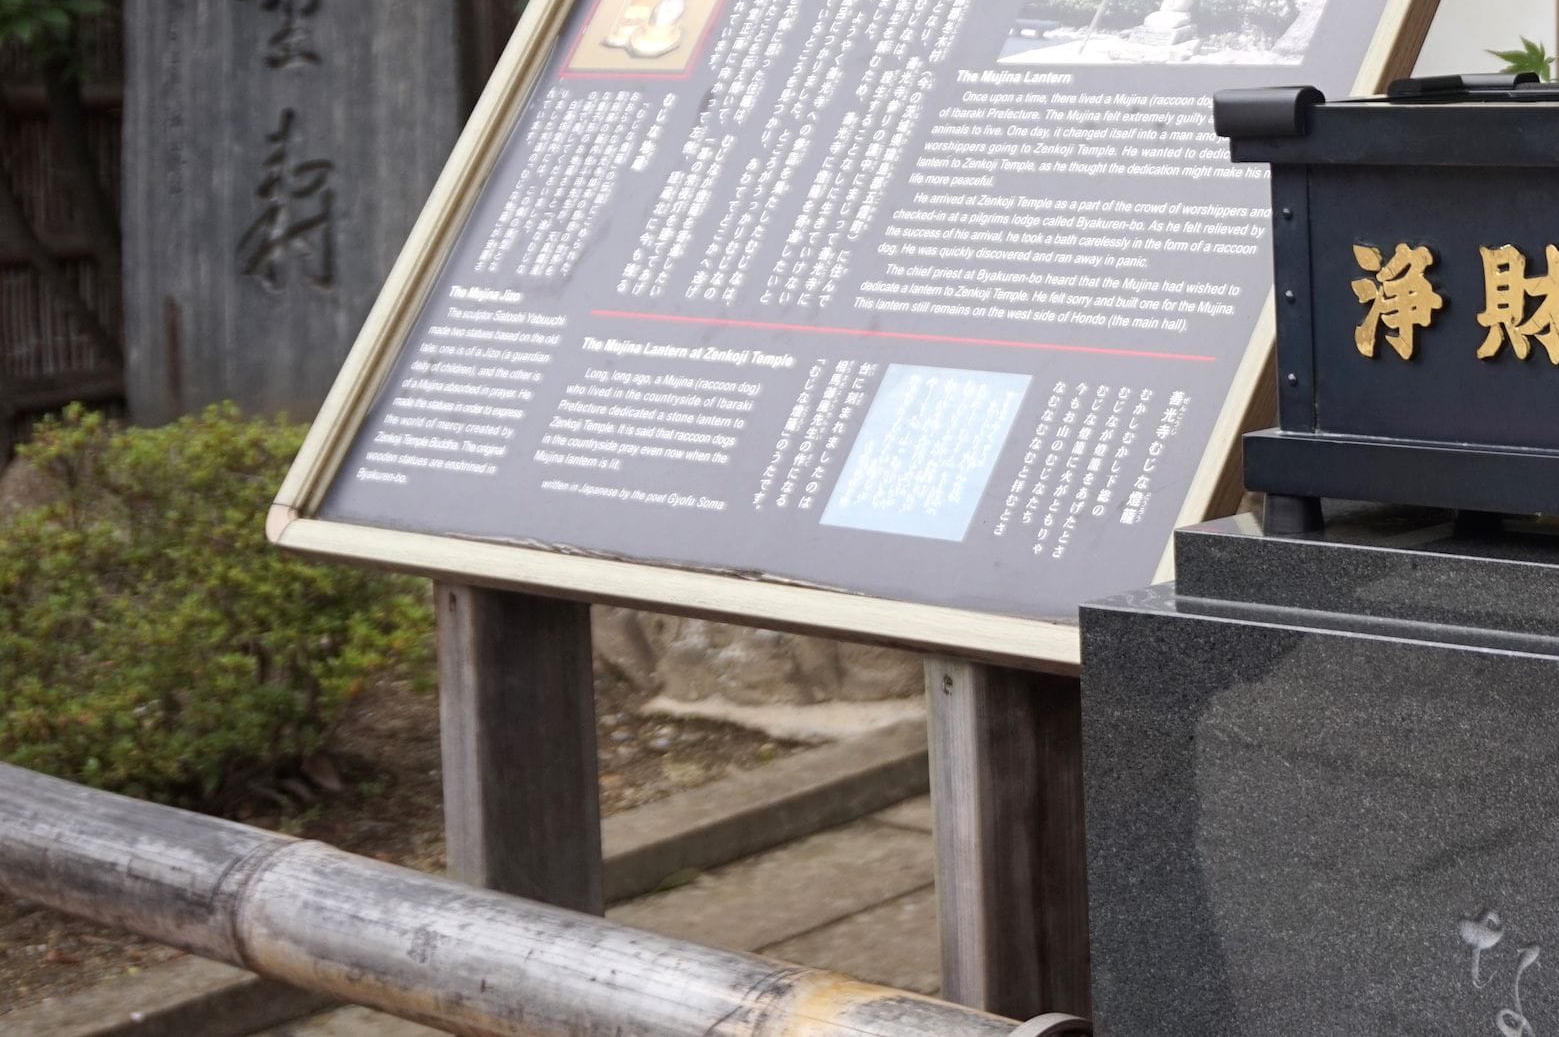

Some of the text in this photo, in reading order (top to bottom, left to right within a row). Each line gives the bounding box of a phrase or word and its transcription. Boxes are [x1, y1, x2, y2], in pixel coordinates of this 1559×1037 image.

[956, 69, 1073, 86] The Mujina Lantern
[908, 171, 995, 188] life more peaceful.
[892, 207, 1270, 240] checked-in at a pilgrims lodge called Byakuren-bo. As he felt relieved by
[885, 262, 1242, 297] The chief priest at Byakuren-bo heard that the Mujina had wished to
[853, 296, 1188, 333] This lantern still remains on the west side of Hondo (the main hall).
[859, 280, 1235, 317] dedicate a lantern to Zenkoji Temple. He felt sorry and built one for the Mujina.
[581, 336, 795, 369] The Mujina Lantern at Zenkoji Temple
[565, 383, 754, 412] who lived in the countryside of Ibaraki
[583, 367, 762, 397] Long, long ago, a Mujina (raccoon dog)
[557, 398, 745, 430] Prefecture dedicated a stone lantern to
[548, 415, 737, 449] Zenkoji Temple. It is said that raccoon dogs
[532, 449, 621, 471] Mujina lantern is lit.
[540, 434, 729, 465] in the countryside pray even now when the
